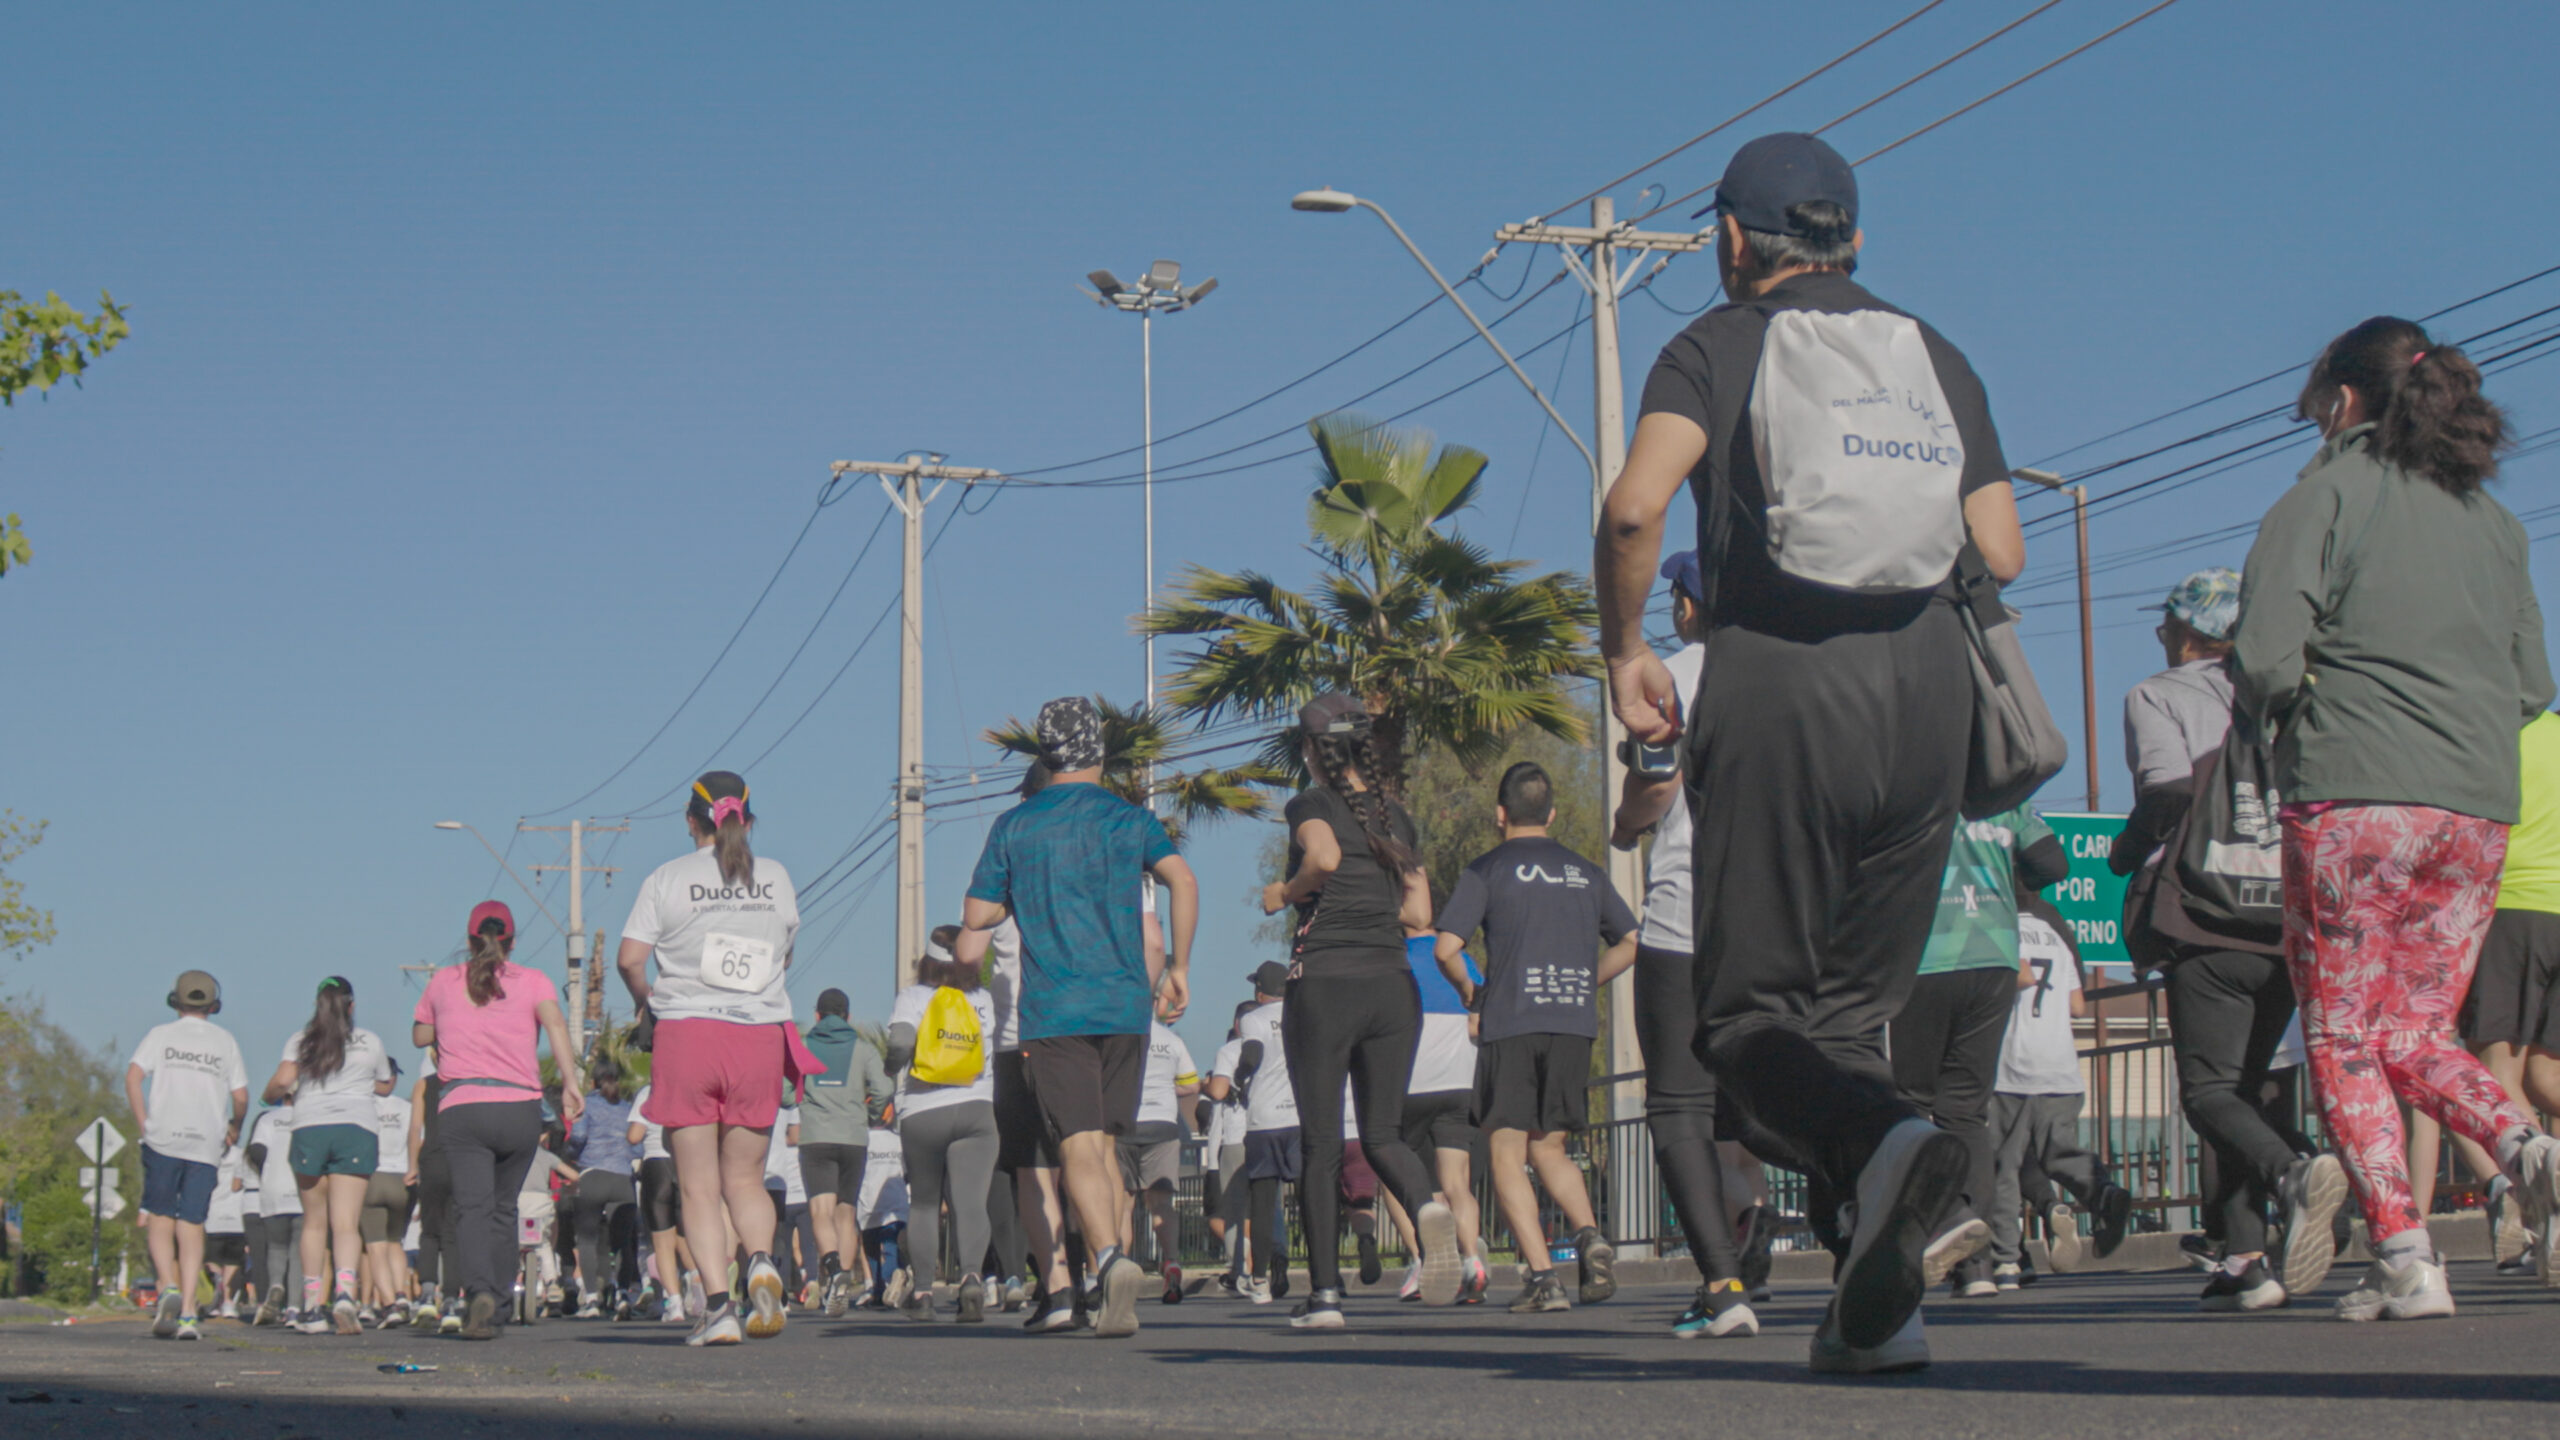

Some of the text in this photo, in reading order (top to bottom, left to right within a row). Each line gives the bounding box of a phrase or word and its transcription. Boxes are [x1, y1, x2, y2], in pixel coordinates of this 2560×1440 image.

[2056, 877, 2096, 901] POR
[721, 951, 752, 980] 65
[2030, 957, 2054, 1018] 7
